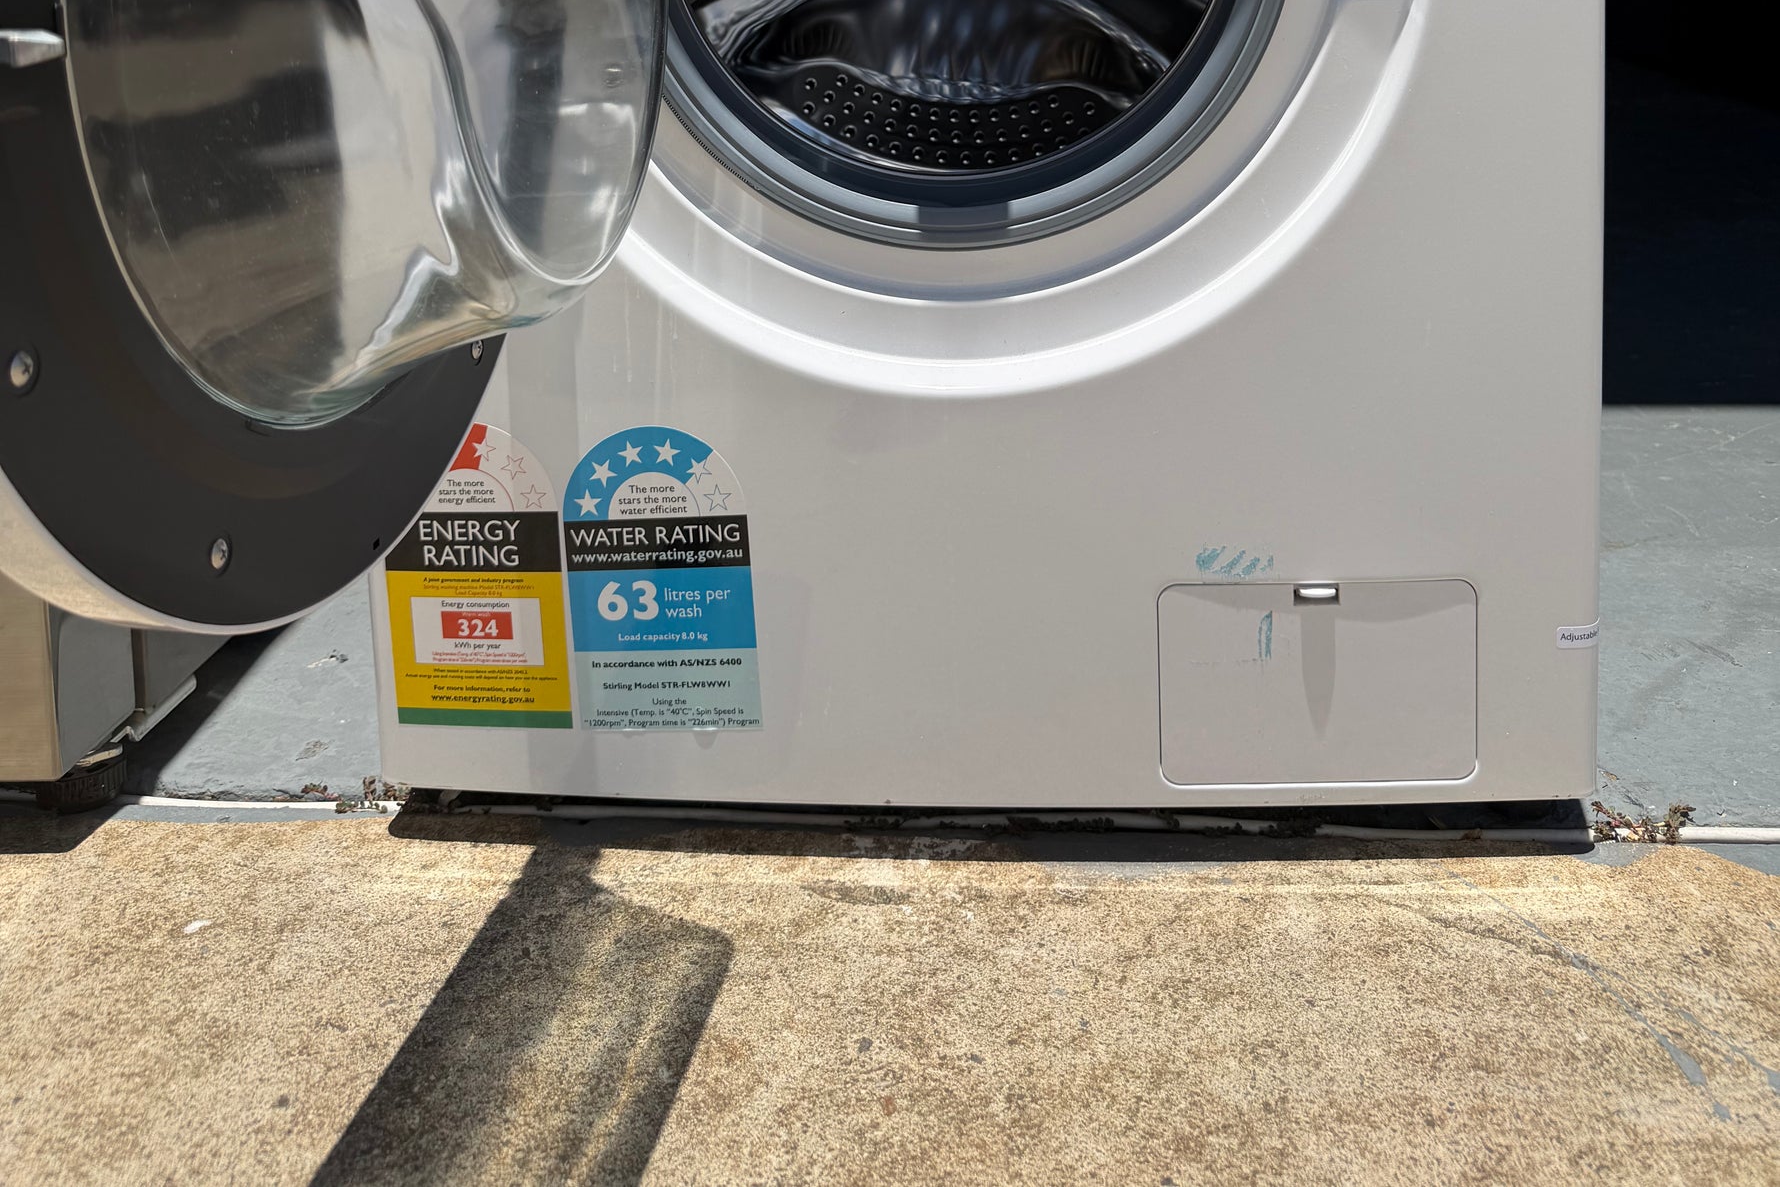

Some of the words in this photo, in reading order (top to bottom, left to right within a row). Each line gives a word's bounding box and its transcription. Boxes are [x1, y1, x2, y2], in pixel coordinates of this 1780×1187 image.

[629, 485, 647, 493] The
[650, 485, 675, 493] more
[439, 497, 463, 505] energy
[419, 520, 520, 541] ENERGY
[570, 527, 649, 548] WATER
[656, 523, 741, 545] RATING
[424, 545, 520, 566] RATING
[572, 548, 743, 564] www.waterrating.gov.au
[664, 587, 701, 601] litres
[706, 589, 730, 603] per
[441, 600, 464, 608] Energy
[466, 601, 509, 609] consumption
[597, 580, 659, 621] 63
[665, 604, 702, 618] wash
[457, 619, 498, 637] 324
[618, 633, 640, 641] Load
[643, 633, 680, 643] capacity
[697, 632, 708, 642] kg
[657, 659, 677, 667] with
[680, 659, 717, 667] AS/NZS
[603, 683, 632, 691] Stirling
[432, 695, 535, 704] www.energyrating.gov.au
[652, 698, 672, 706] Using
[696, 708, 712, 716] Spin
[629, 719, 659, 727] Program
[727, 717, 760, 726] Program
